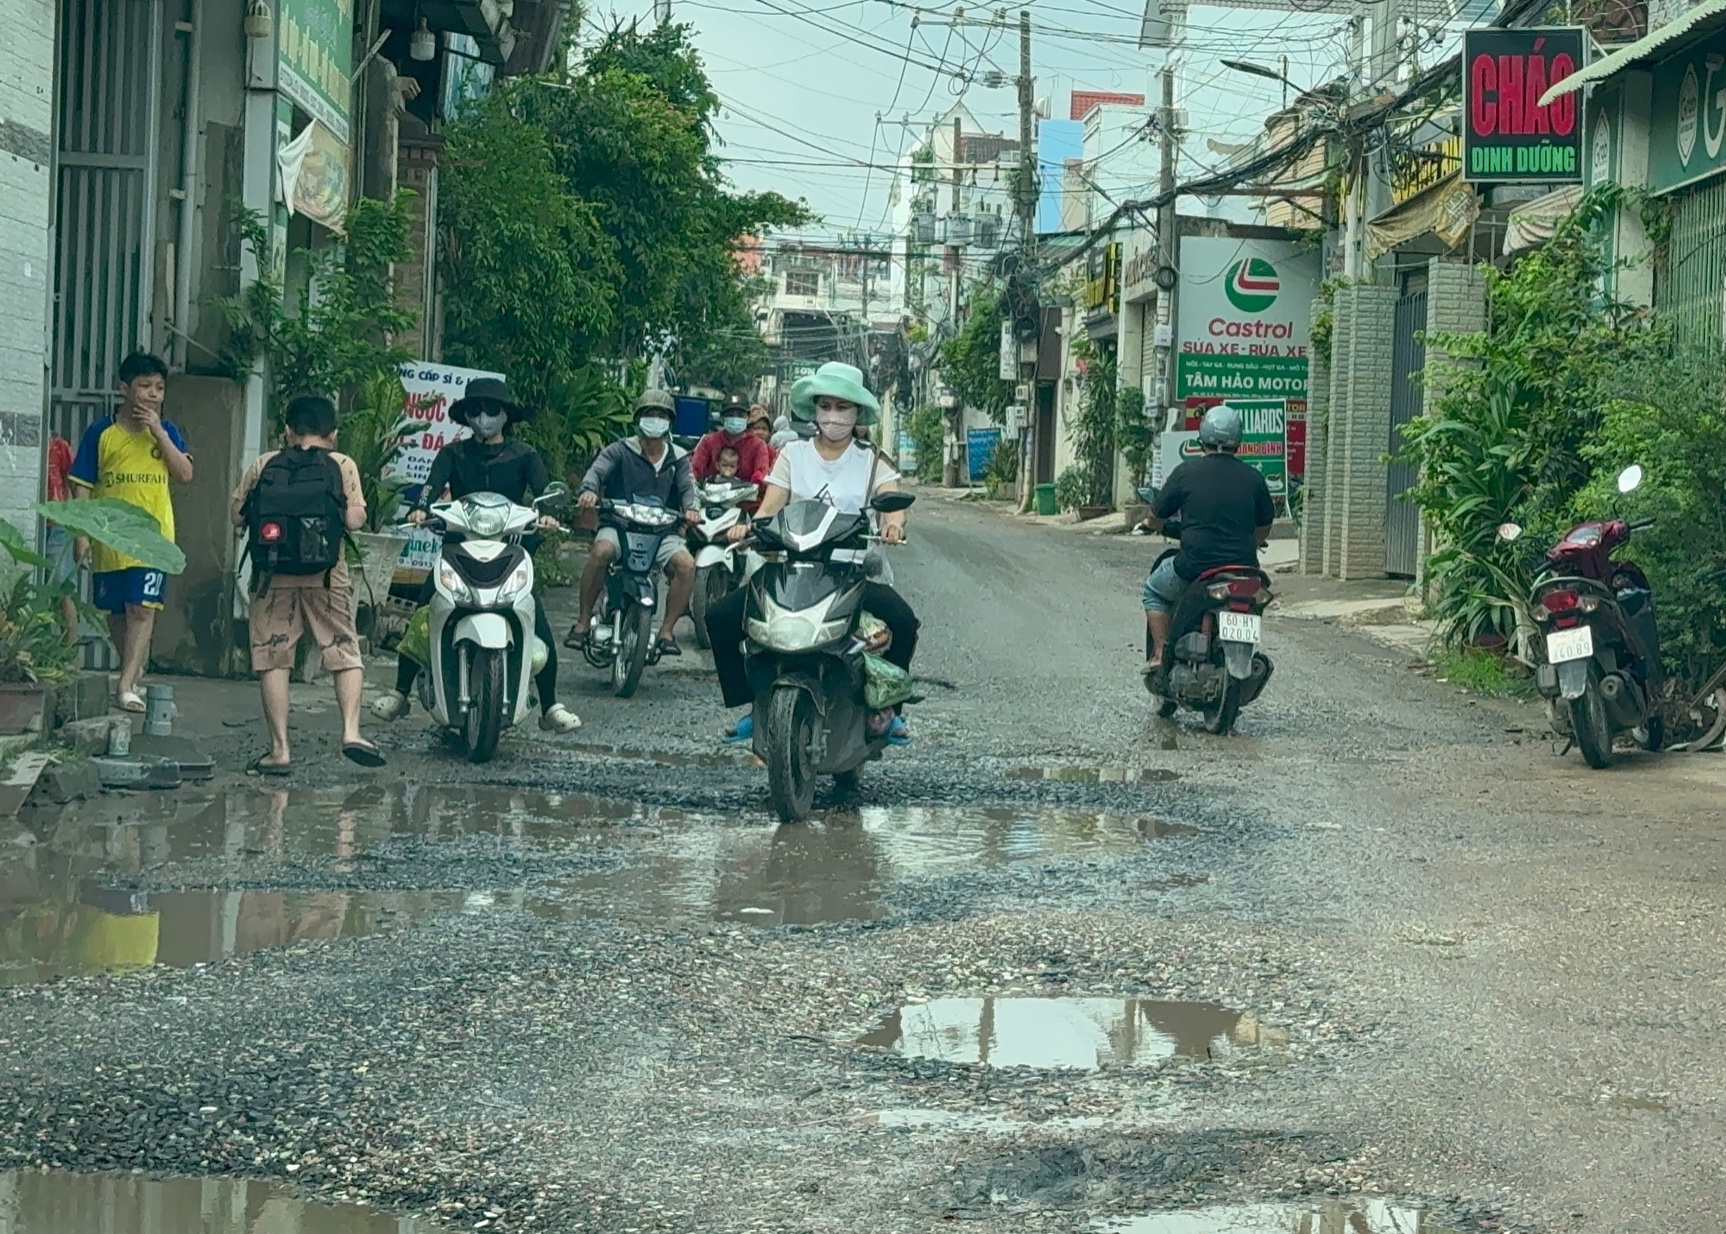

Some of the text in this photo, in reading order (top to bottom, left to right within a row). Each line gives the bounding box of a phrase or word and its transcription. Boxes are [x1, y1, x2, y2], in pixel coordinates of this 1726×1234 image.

[1472, 37, 1575, 137] CHÁO
[1472, 147, 1513, 173] DINH
[1517, 138, 1576, 173] DƯỠNG
[1208, 317, 1293, 339] Castrol
[1183, 338, 1308, 359] SỬA XE RỬA XE
[397, 368, 415, 379] NG
[455, 376, 464, 386] &
[1185, 371, 1216, 388] TÂM
[1221, 372, 1254, 389] HẢO
